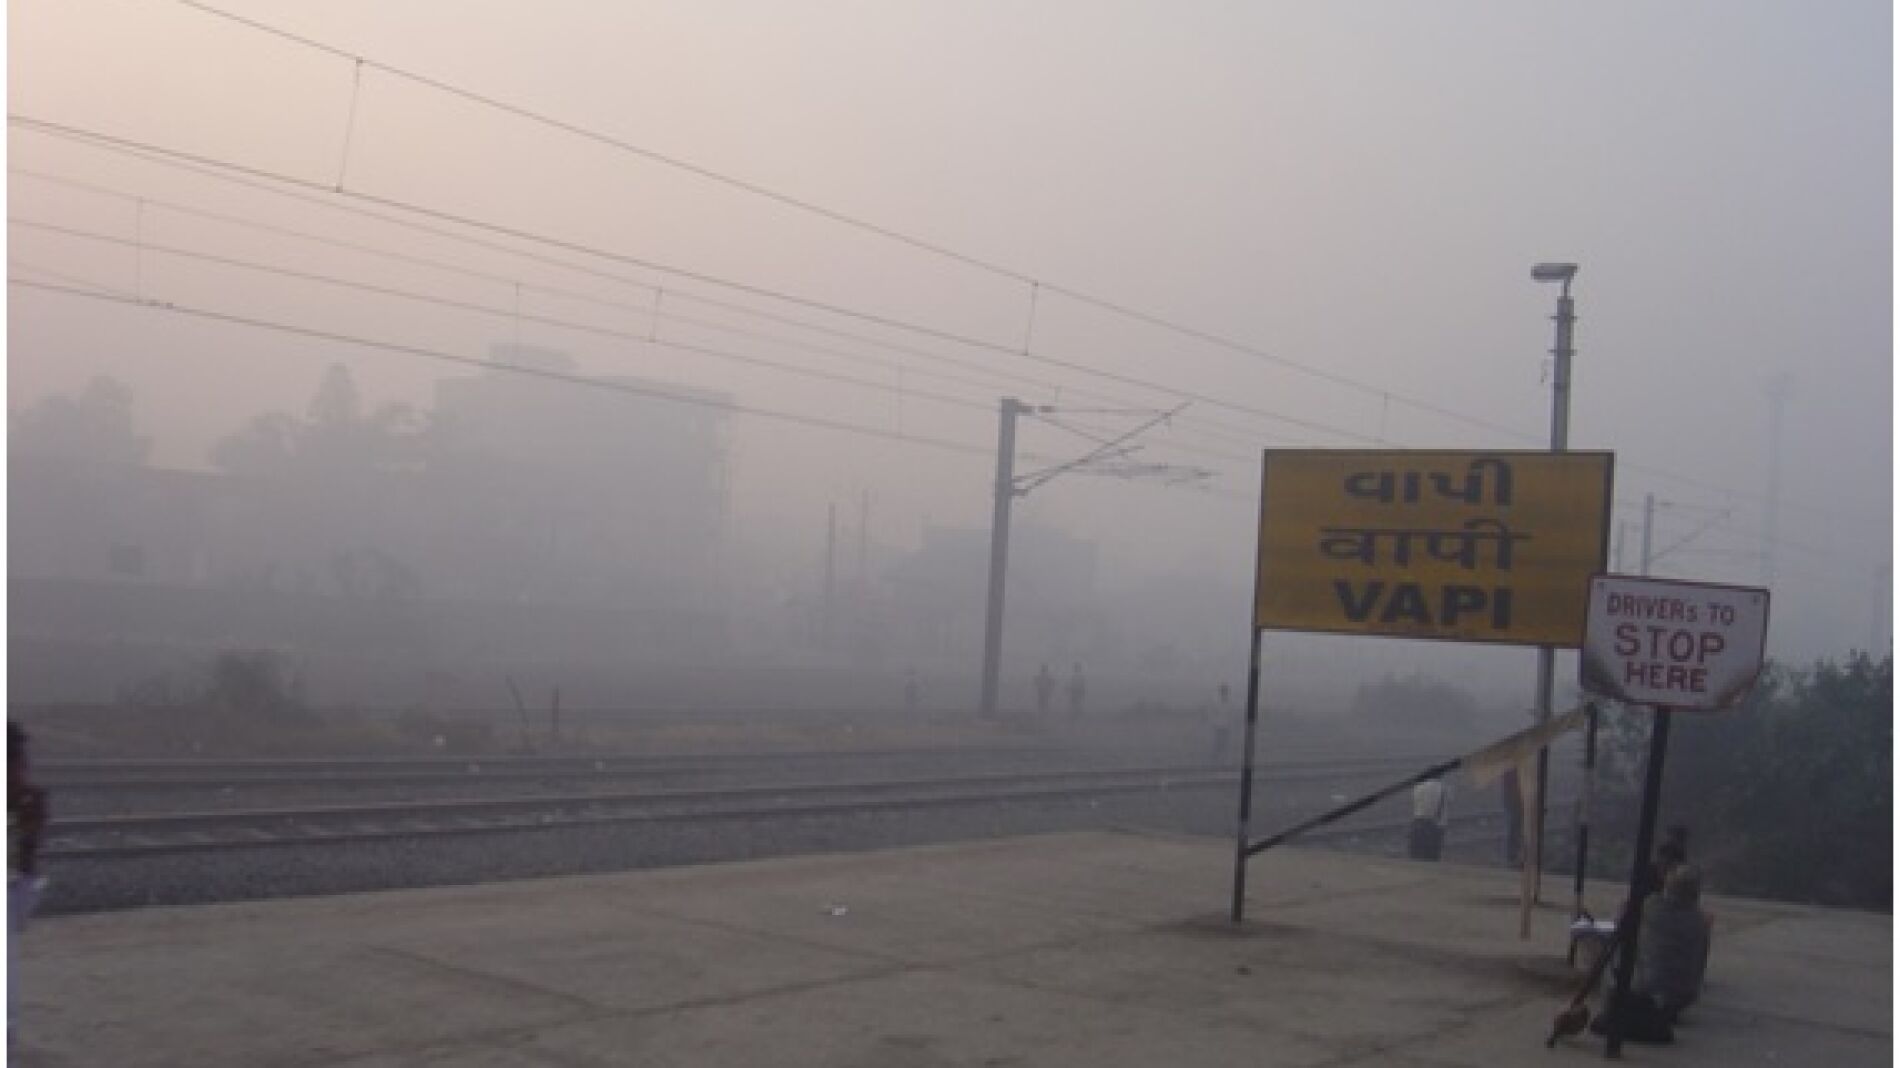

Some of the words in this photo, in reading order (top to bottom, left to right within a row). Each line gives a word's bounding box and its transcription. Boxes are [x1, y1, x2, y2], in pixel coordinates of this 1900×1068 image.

[1344, 458, 1514, 506] વાપી
[1319, 518, 1532, 570] वापी
[1332, 580, 1514, 630] VAPI
[1707, 602, 1735, 626] TO
[1614, 622, 1725, 665] STOP
[1625, 661, 1708, 693] HERE
